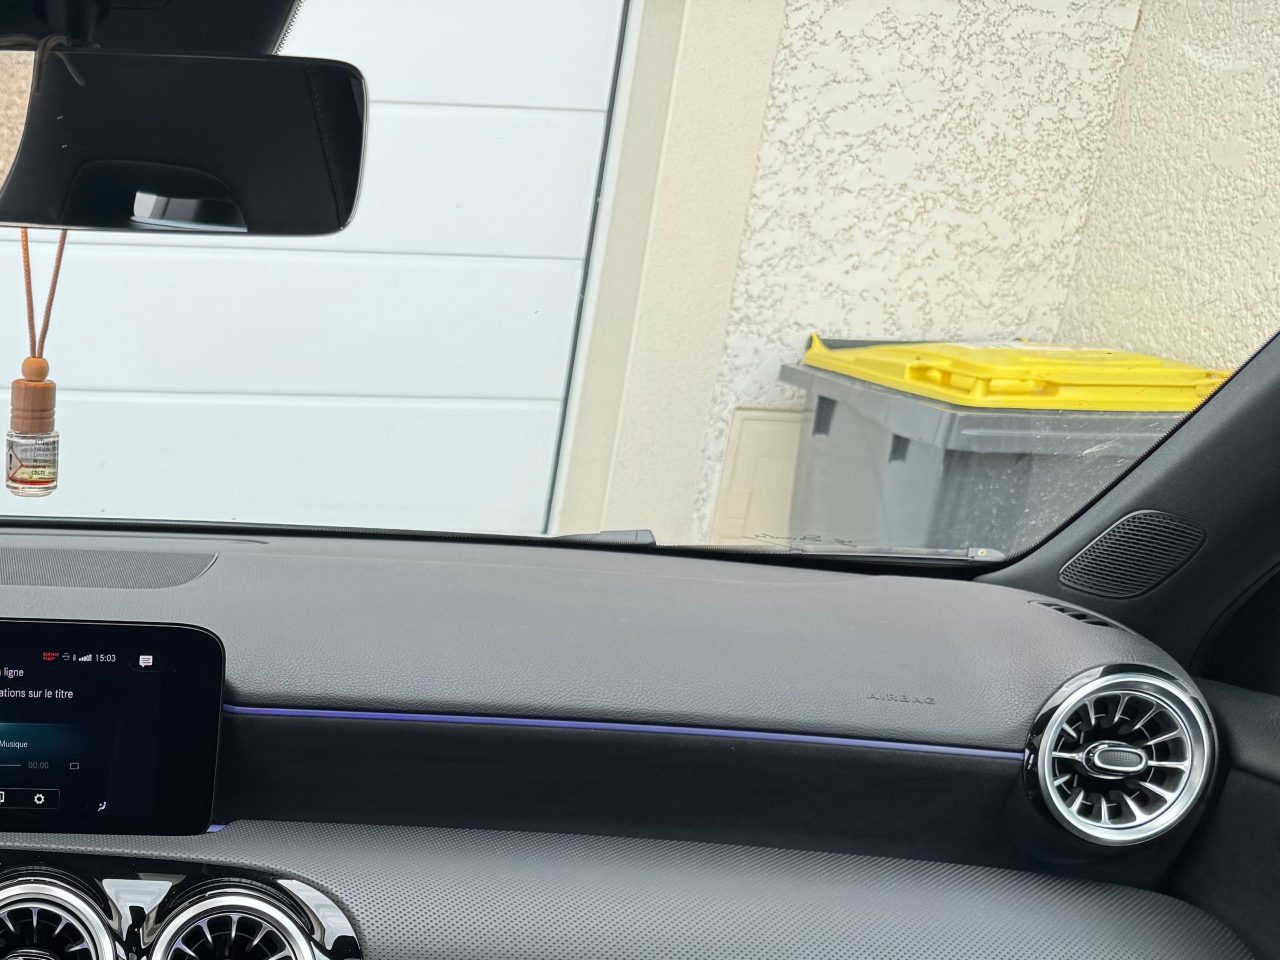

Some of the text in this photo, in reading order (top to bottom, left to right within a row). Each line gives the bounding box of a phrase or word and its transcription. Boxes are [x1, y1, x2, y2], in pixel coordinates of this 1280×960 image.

[95, 654, 116, 662] 15:03
[3, 667, 24, 678] ligne
[28, 690, 43, 698] sur
[44, 688, 53, 698] le
[55, 688, 74, 699] titre
[0, 740, 28, 749] Musique
[28, 761, 49, 769] 00:00
